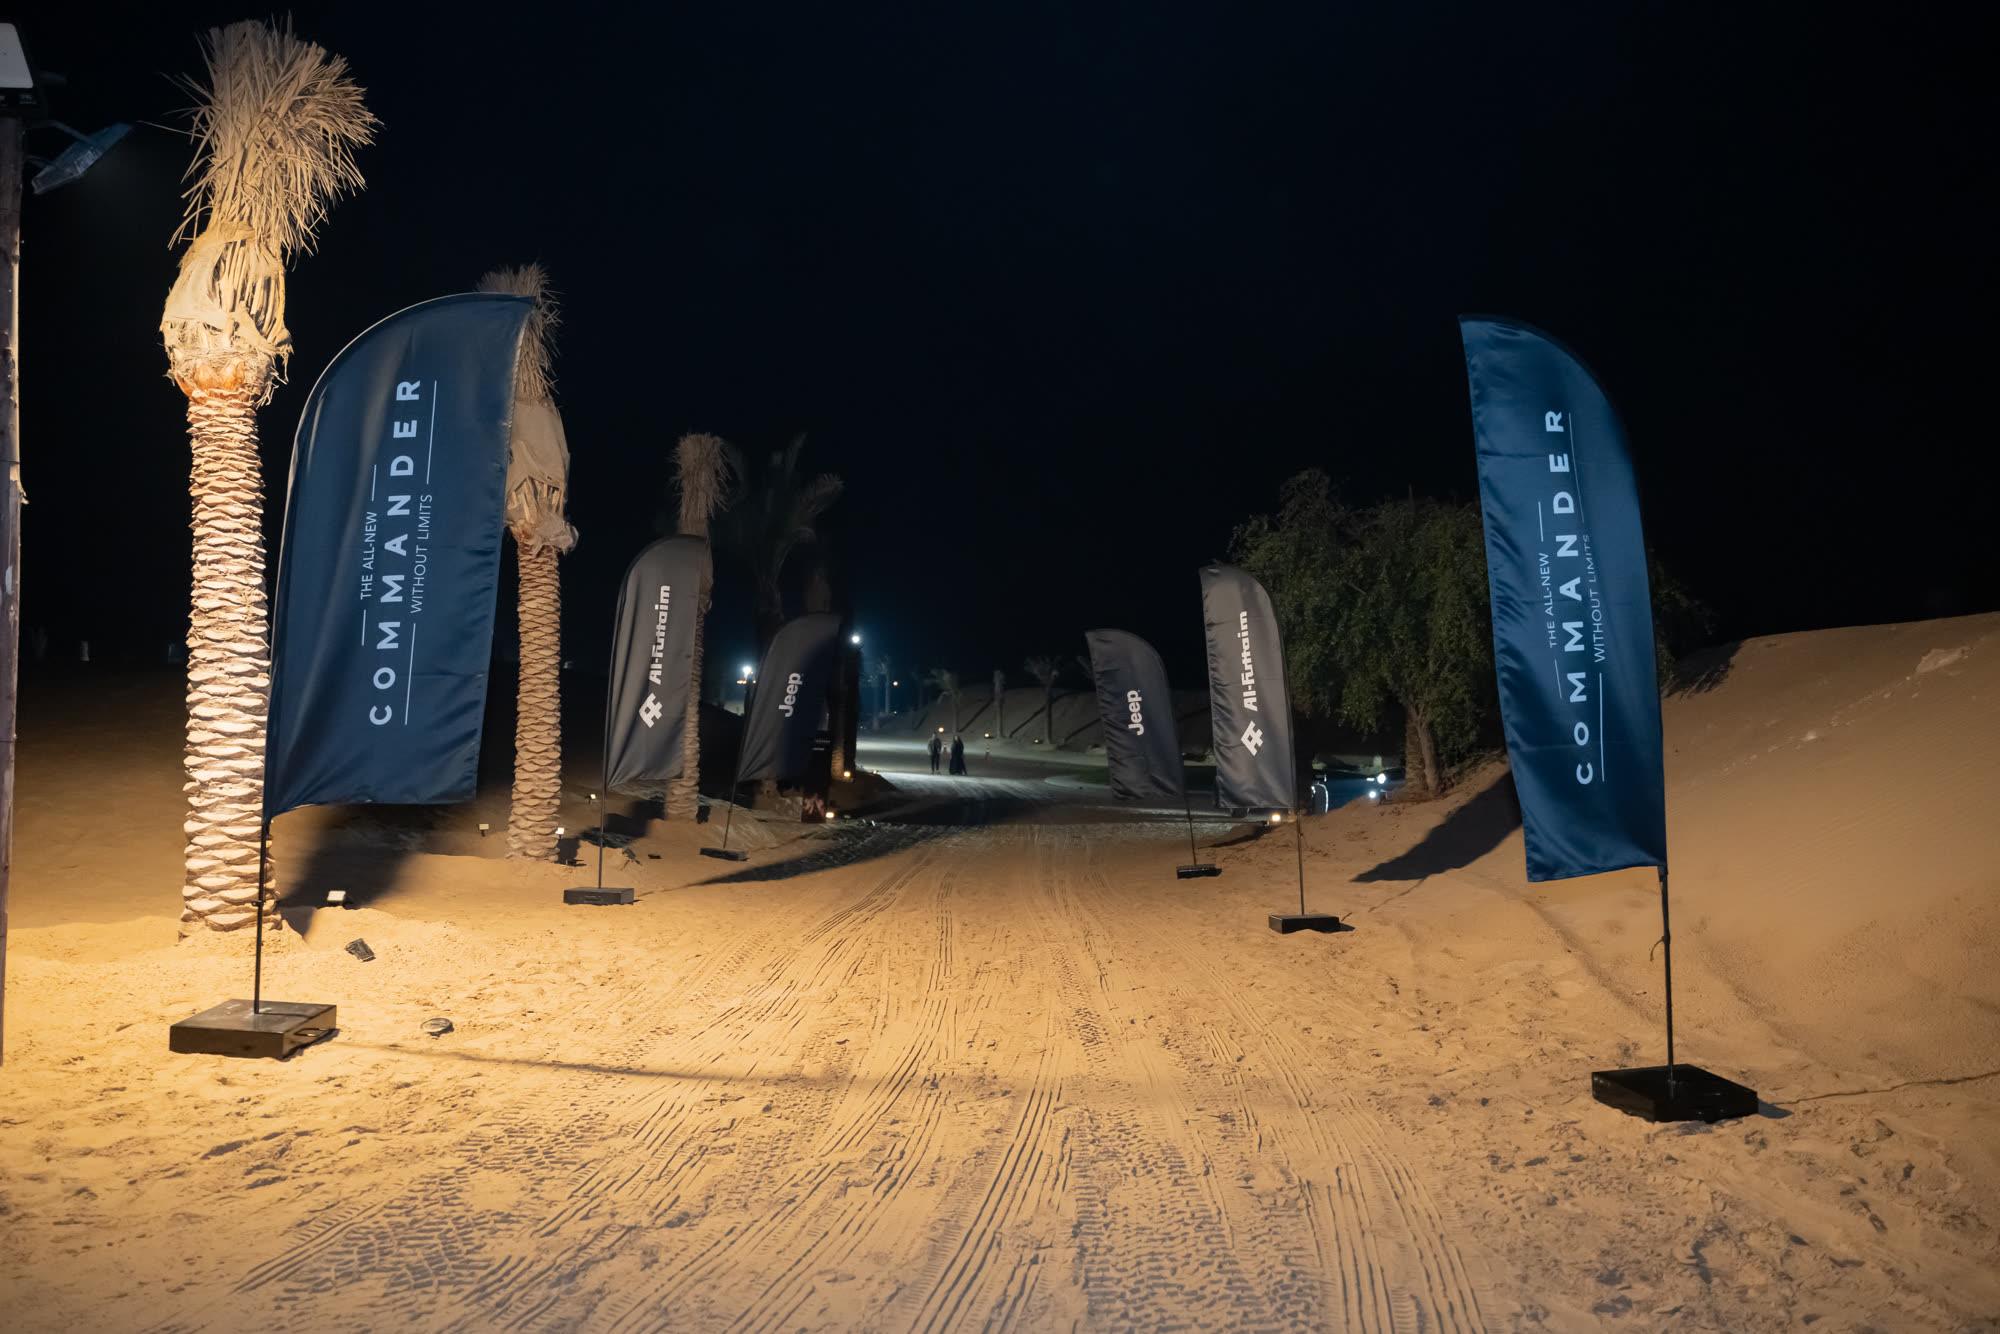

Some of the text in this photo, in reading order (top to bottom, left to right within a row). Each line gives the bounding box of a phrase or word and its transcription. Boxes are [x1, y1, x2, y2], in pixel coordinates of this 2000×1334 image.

[360, 511, 378, 600] THE ALL-NEW
[369, 380, 420, 726] COMMANDER
[410, 494, 433, 614] WITHOUT LIMITS
[1539, 552, 1557, 648] THE ALL-NEW
[1545, 410, 1594, 785] COMMANDER
[1583, 534, 1605, 663] WITHOUT LIMITS
[649, 585, 671, 685] Al-Futtaim
[1237, 611, 1257, 711] Al-Futtaim
[778, 672, 803, 718] Jeep
[1127, 690, 1144, 736] Jeep
